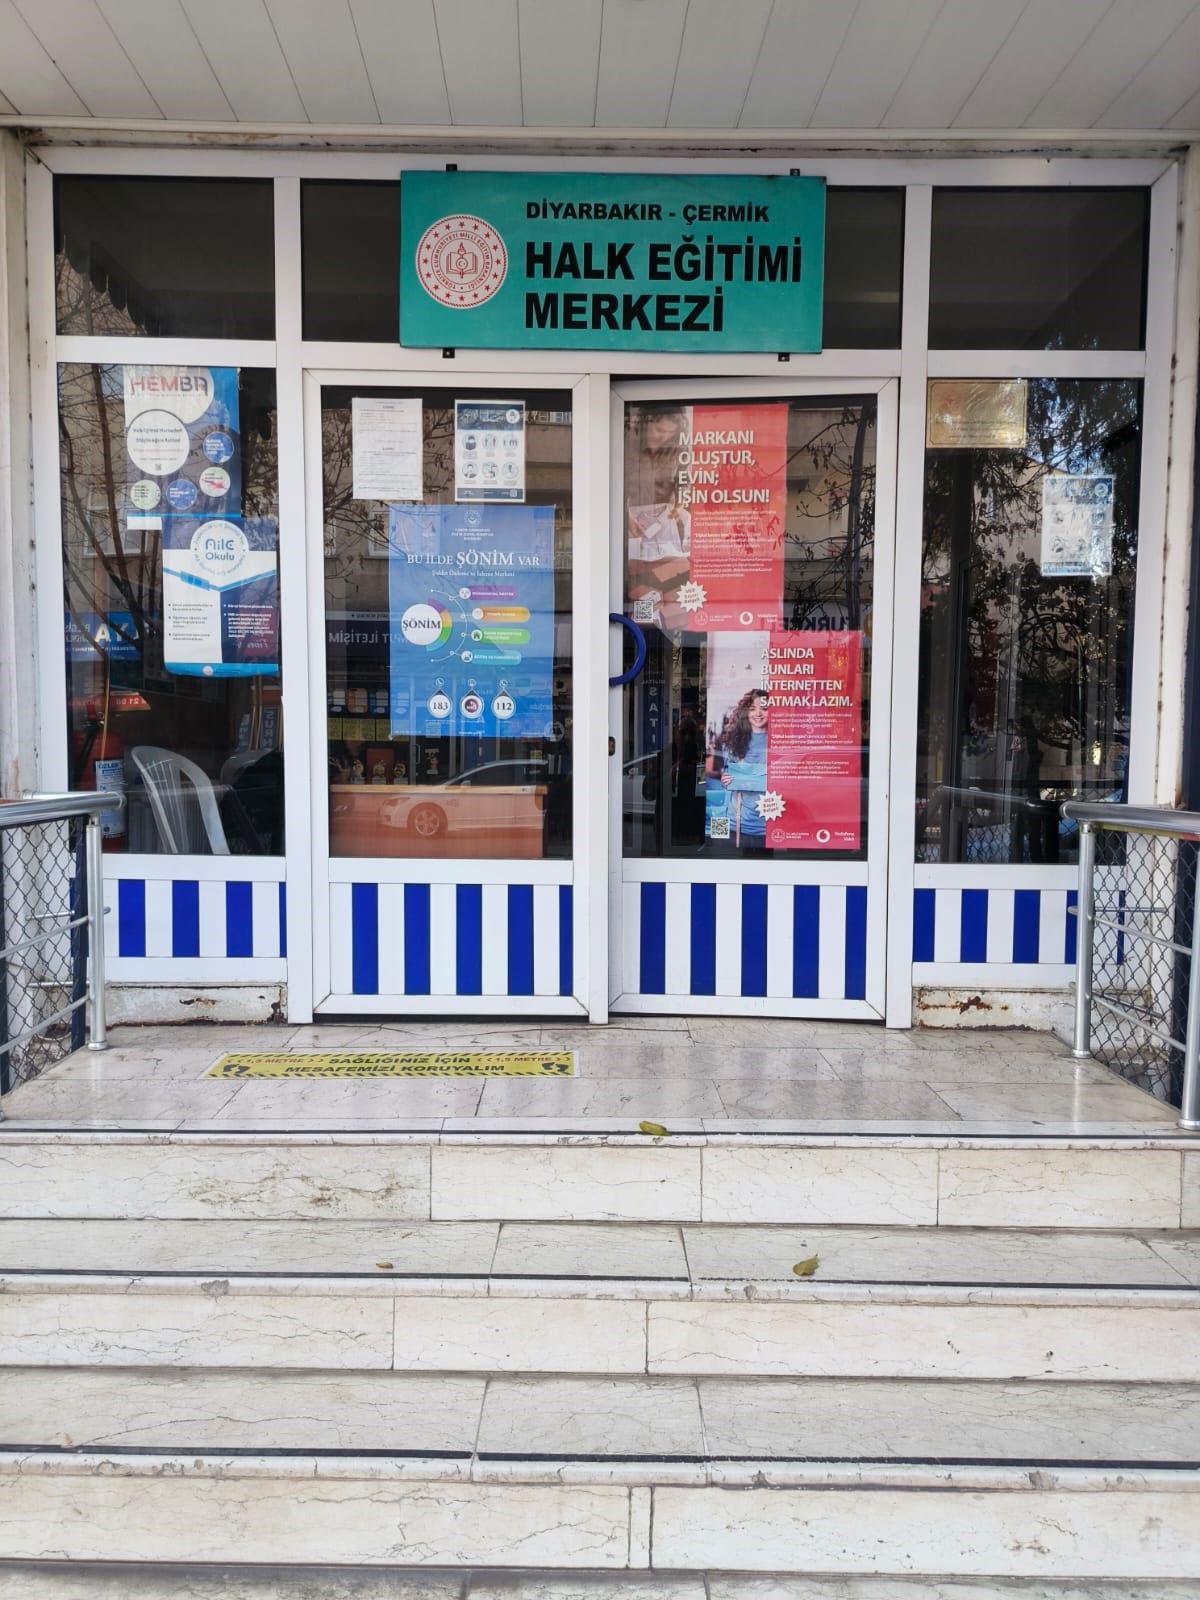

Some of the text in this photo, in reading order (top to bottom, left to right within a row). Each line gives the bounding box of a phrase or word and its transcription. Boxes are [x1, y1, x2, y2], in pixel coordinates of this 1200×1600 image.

[526, 198, 663, 221] DİYARBAKIR
[683, 201, 770, 226] ÇERMİK
[525, 235, 802, 283] HALK EĞİTİMİ
[524, 286, 725, 332] MERKEZİ
[678, 430, 754, 446] MARKANI
[678, 451, 756, 469] OLUŞTUR,
[678, 468, 720, 486] EVİN;
[678, 487, 770, 507] İŞİN OLSUN!
[205, 551, 235, 561] Okulu
[407, 549, 540, 569] BU İLDE ŞÖNİM VAR
[402, 619, 441, 632] ŞÖNİM
[761, 647, 814, 659] ASLINDA
[760, 664, 814, 675] BUNLARI
[432, 701, 449, 711] 183
[496, 702, 512, 711] 112
[759, 695, 854, 707] SATMAK LAZIM.
[434, 1056, 472, 1064] İÇİN
[284, 1065, 396, 1073] MESAFEMİZİ
